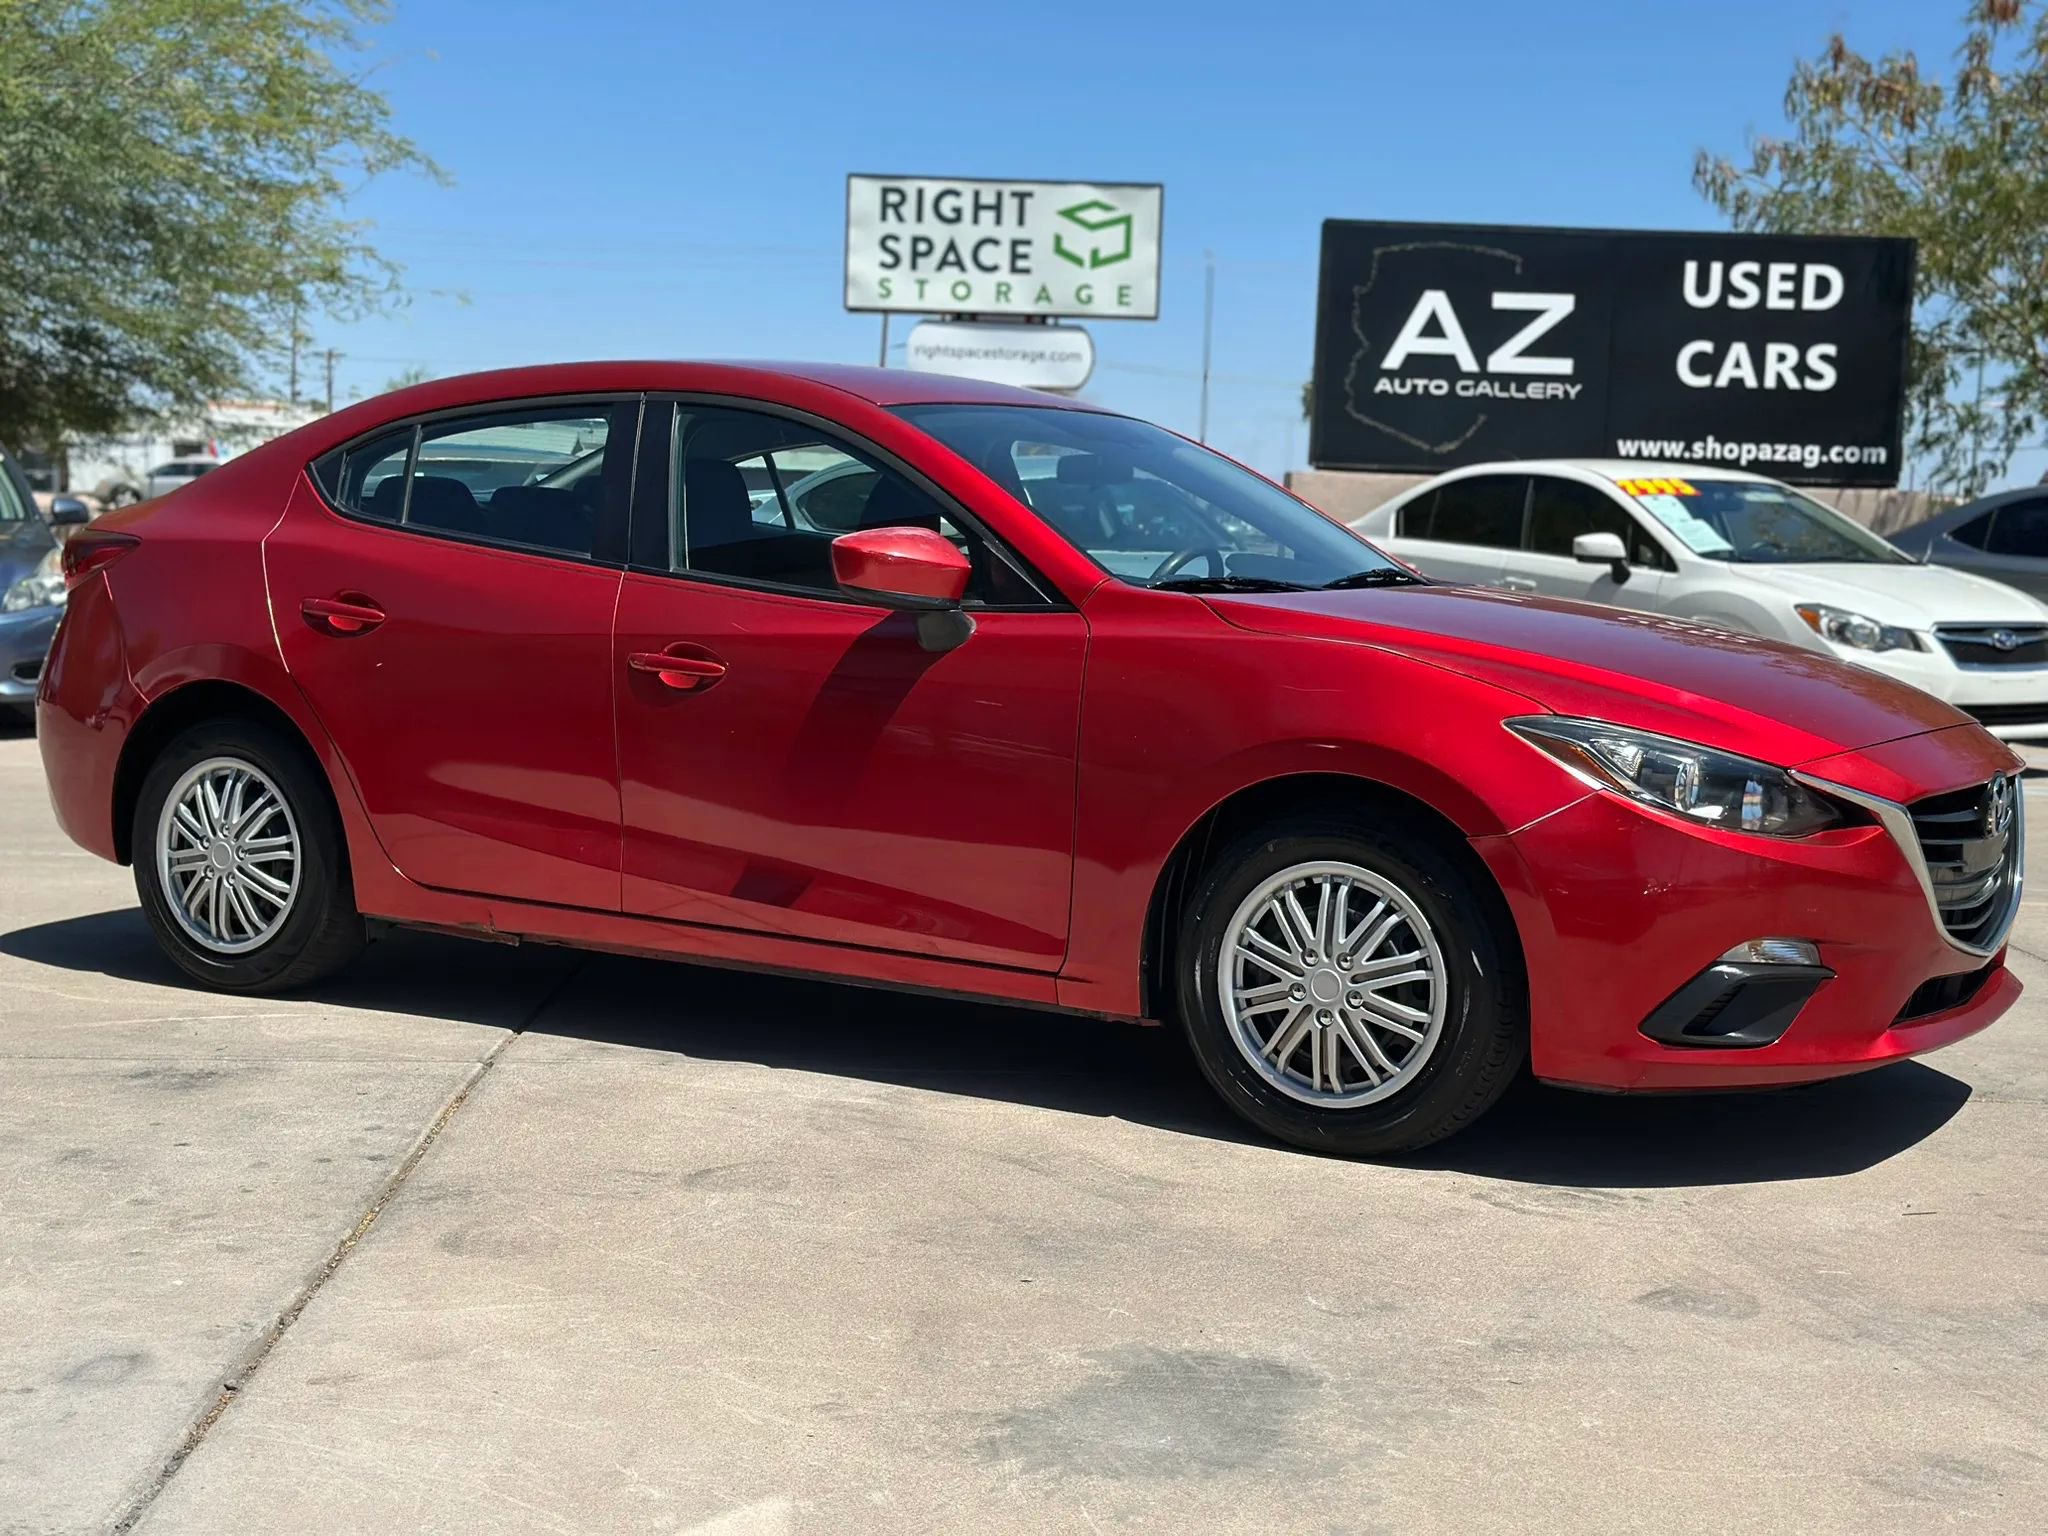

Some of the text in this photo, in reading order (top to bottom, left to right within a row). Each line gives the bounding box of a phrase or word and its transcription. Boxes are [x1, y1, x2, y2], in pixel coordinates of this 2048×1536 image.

[880, 186, 1035, 227] RIGHT
[878, 234, 1033, 275] SPACE
[878, 279, 1132, 306] STORAGE
[1682, 259, 1845, 312] USED
[1380, 290, 1575, 375] AZ
[914, 344, 1083, 365] rightspacestorage.com
[1675, 340, 1838, 392] CARS
[1374, 377, 1582, 400] AUTO GALLERY
[1616, 435, 1887, 468] www.shopazag.com
